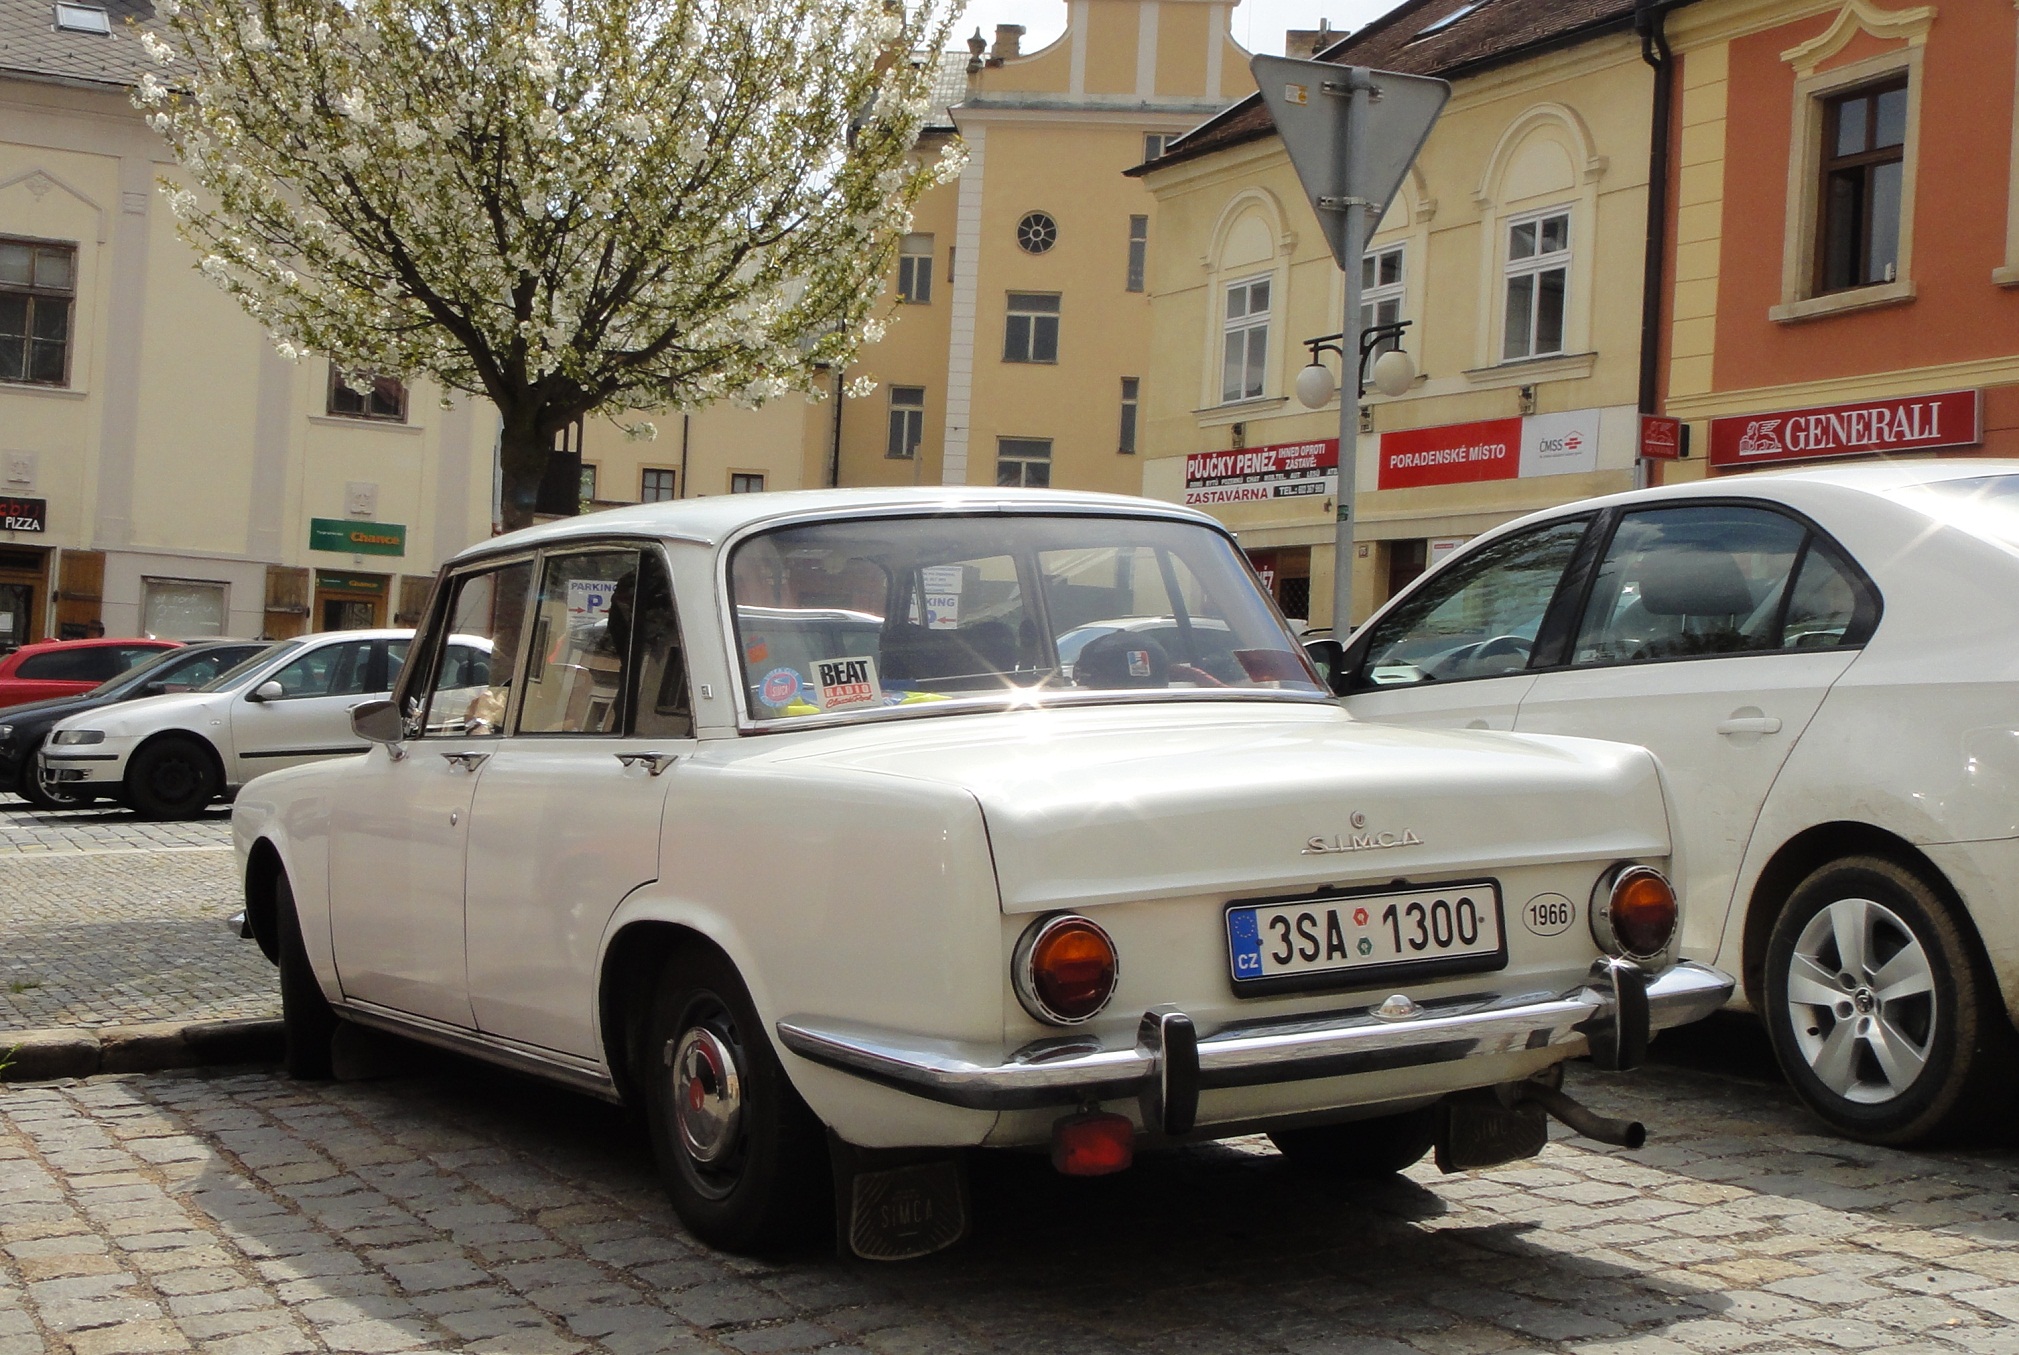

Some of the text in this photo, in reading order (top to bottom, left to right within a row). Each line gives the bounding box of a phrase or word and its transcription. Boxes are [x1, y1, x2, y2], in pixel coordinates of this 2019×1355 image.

[1785, 402, 1942, 451] GENERALI
[1278, 443, 1326, 459] IHNED OPROTI
[1389, 442, 1506, 469] PORADENSKÉ MÍSTO
[1539, 437, 1563, 454] ČMSS
[1187, 447, 1277, 479] PŮJČKY PENĚZ
[1186, 487, 1268, 505] ZASTAVÁRNA
[5, 516, 41, 531] PIZZA
[350, 531, 400, 545] Chance
[818, 660, 868, 687] BEAT
[825, 683, 870, 697] RADIO
[1301, 828, 1424, 855] SIMCA
[1529, 906, 1568, 927] 1966
[1268, 896, 1479, 965] 3SA 1300
[1238, 952, 1259, 971] CZ
